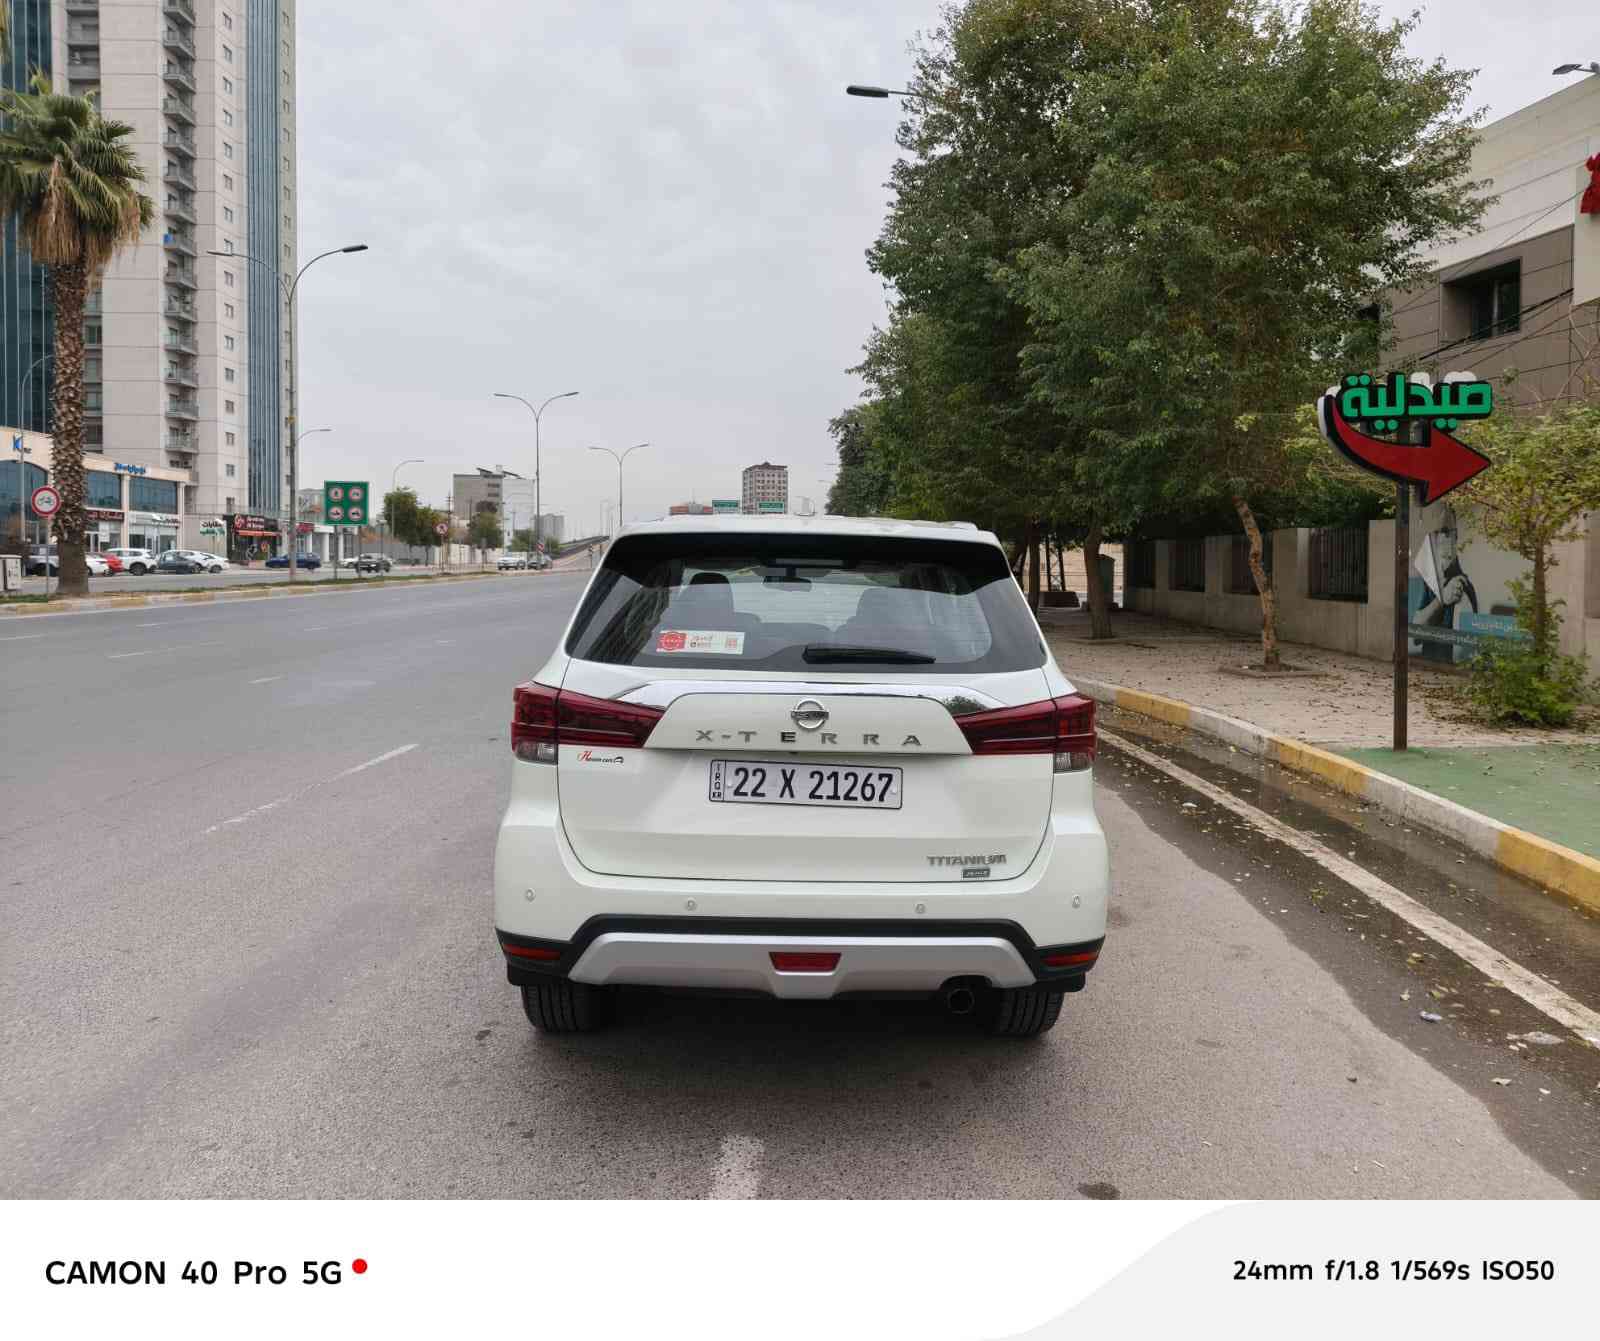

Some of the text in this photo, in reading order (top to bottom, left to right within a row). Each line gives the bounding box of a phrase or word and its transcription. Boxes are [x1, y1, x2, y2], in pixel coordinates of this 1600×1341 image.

[1342, 374, 1492, 430] صيدلية
[695, 729, 922, 746] X-TERRA
[733, 767, 894, 802] 22 X 21267
[927, 854, 1007, 867] TITANIUM
